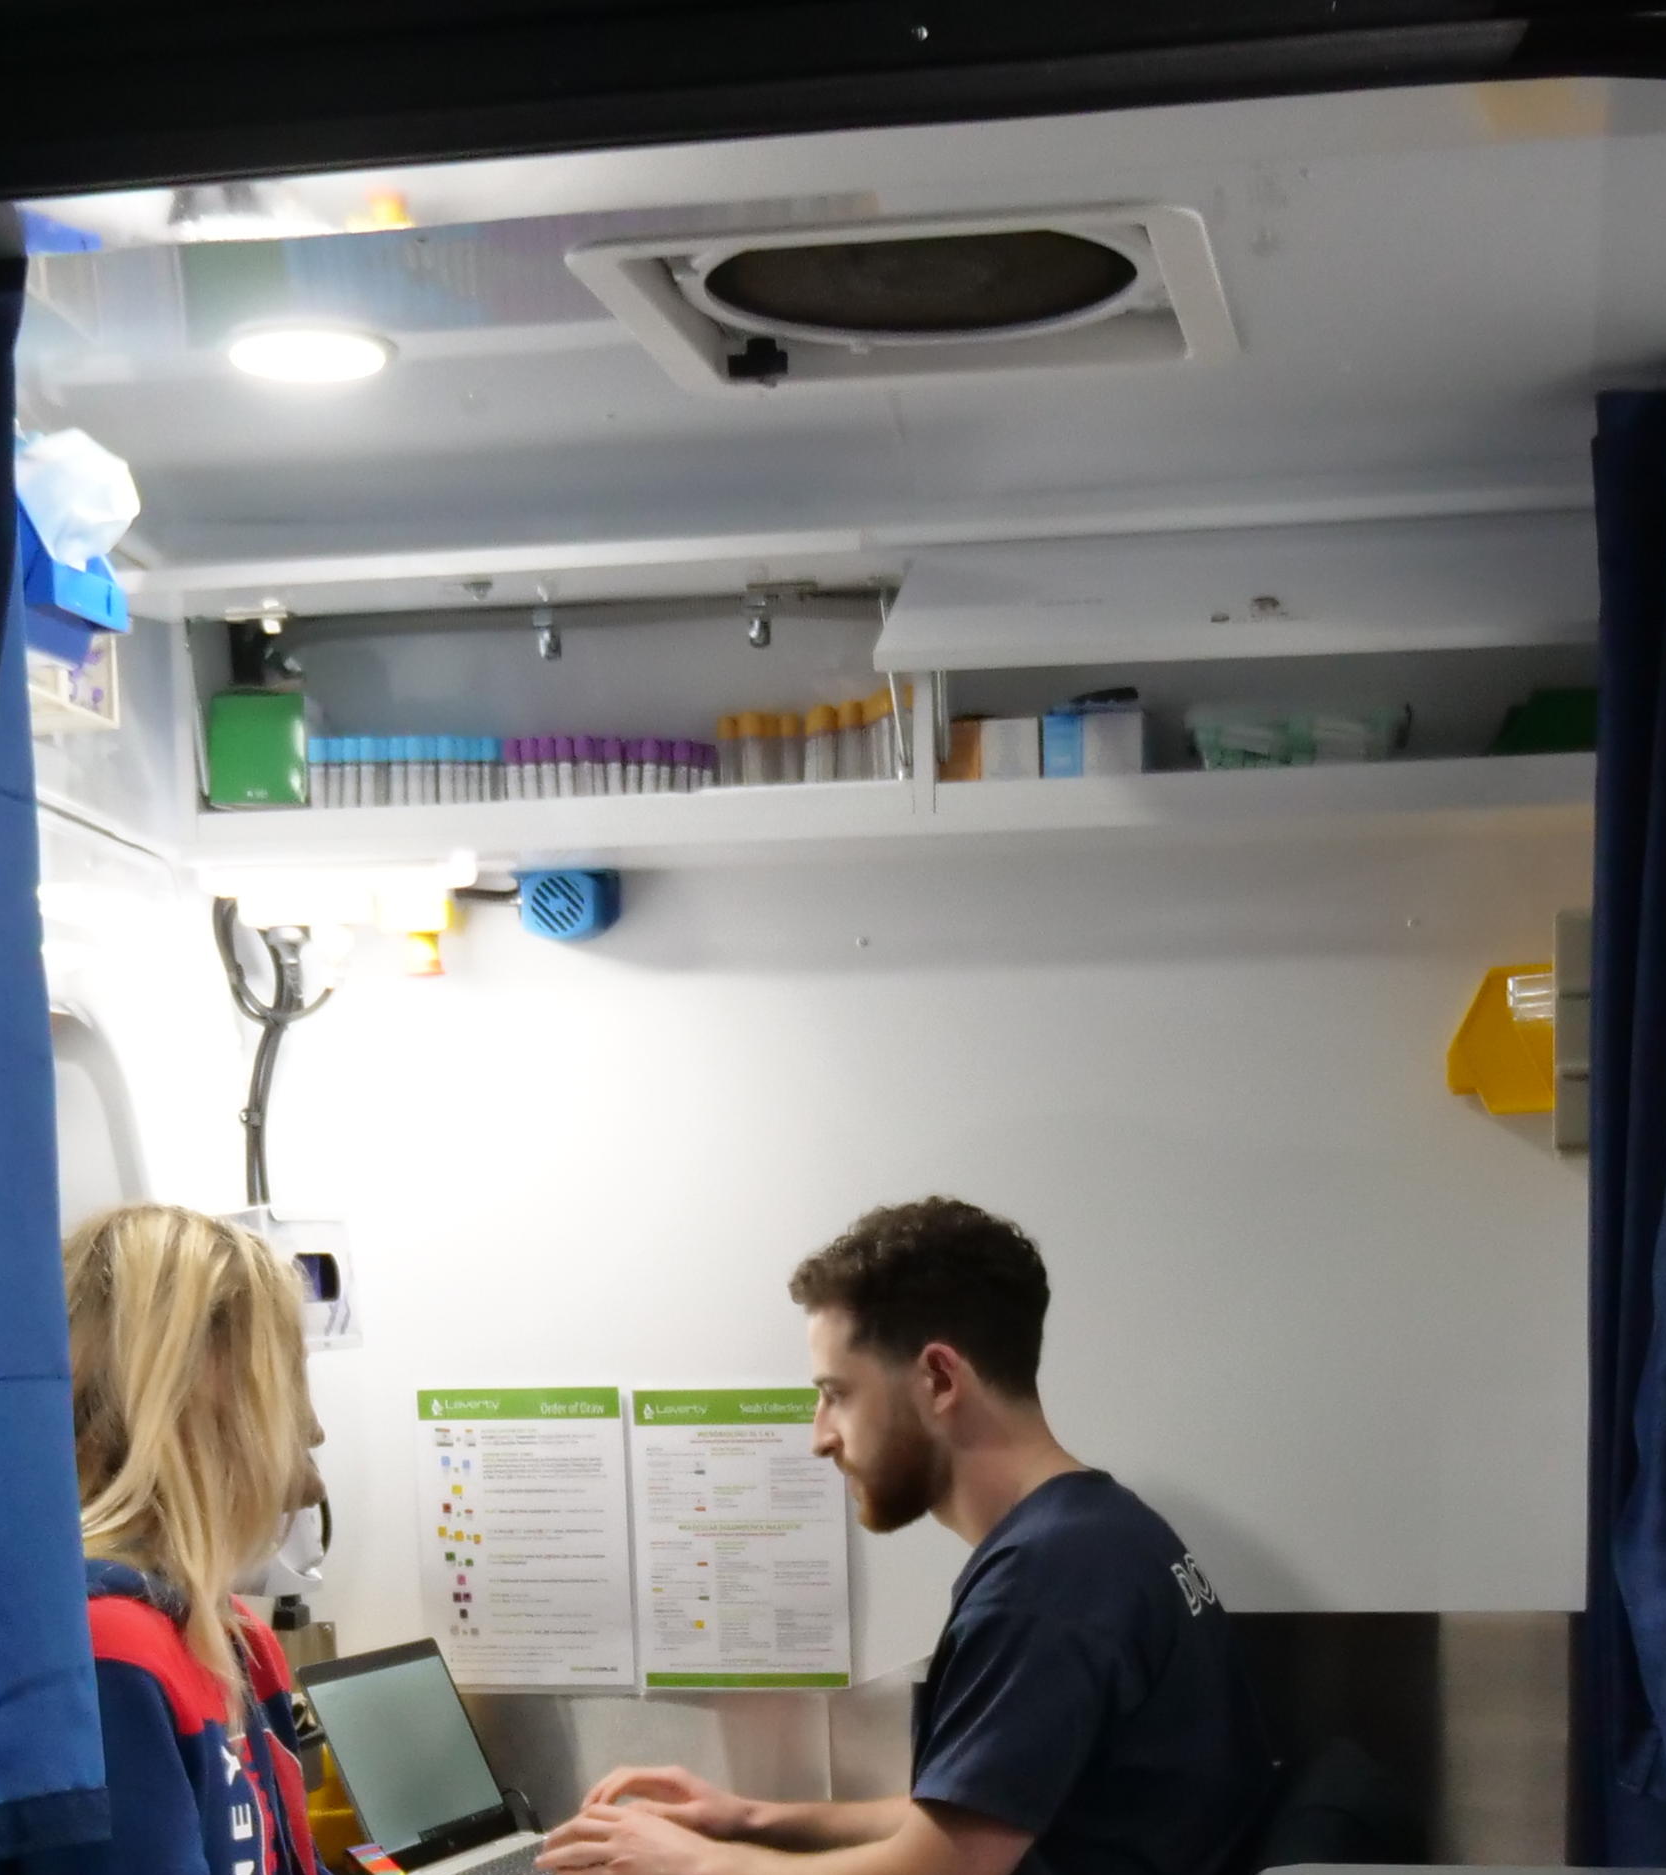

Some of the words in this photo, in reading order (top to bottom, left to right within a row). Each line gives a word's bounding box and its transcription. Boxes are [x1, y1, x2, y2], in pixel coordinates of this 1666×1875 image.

[540, 1401, 565, 1415] Order
[567, 1401, 579, 1414] of
[579, 1401, 605, 1415] Draw
